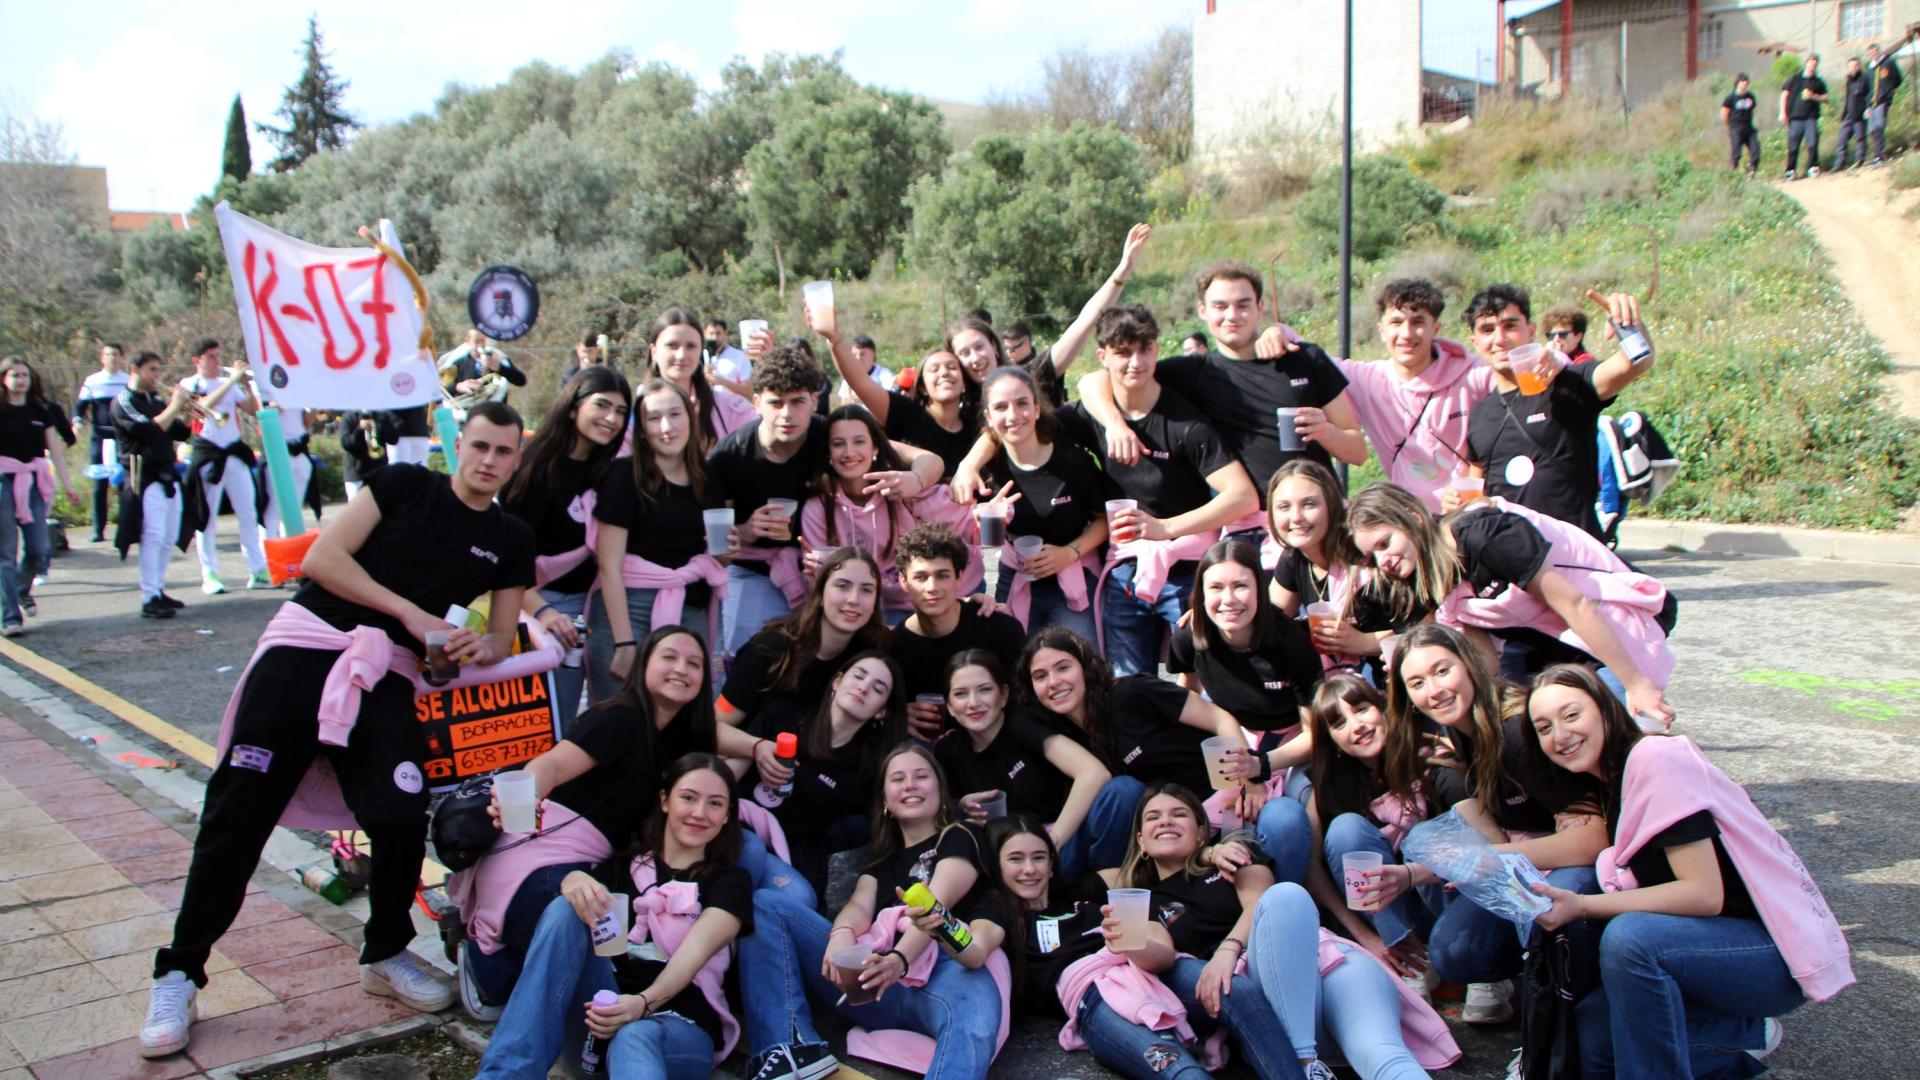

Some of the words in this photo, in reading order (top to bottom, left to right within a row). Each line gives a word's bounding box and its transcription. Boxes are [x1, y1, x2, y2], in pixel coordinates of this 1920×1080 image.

[244, 240, 394, 369] K-07
[416, 693, 445, 722] SE
[452, 673, 546, 716] ALQUILA
[461, 748, 497, 769] 658
